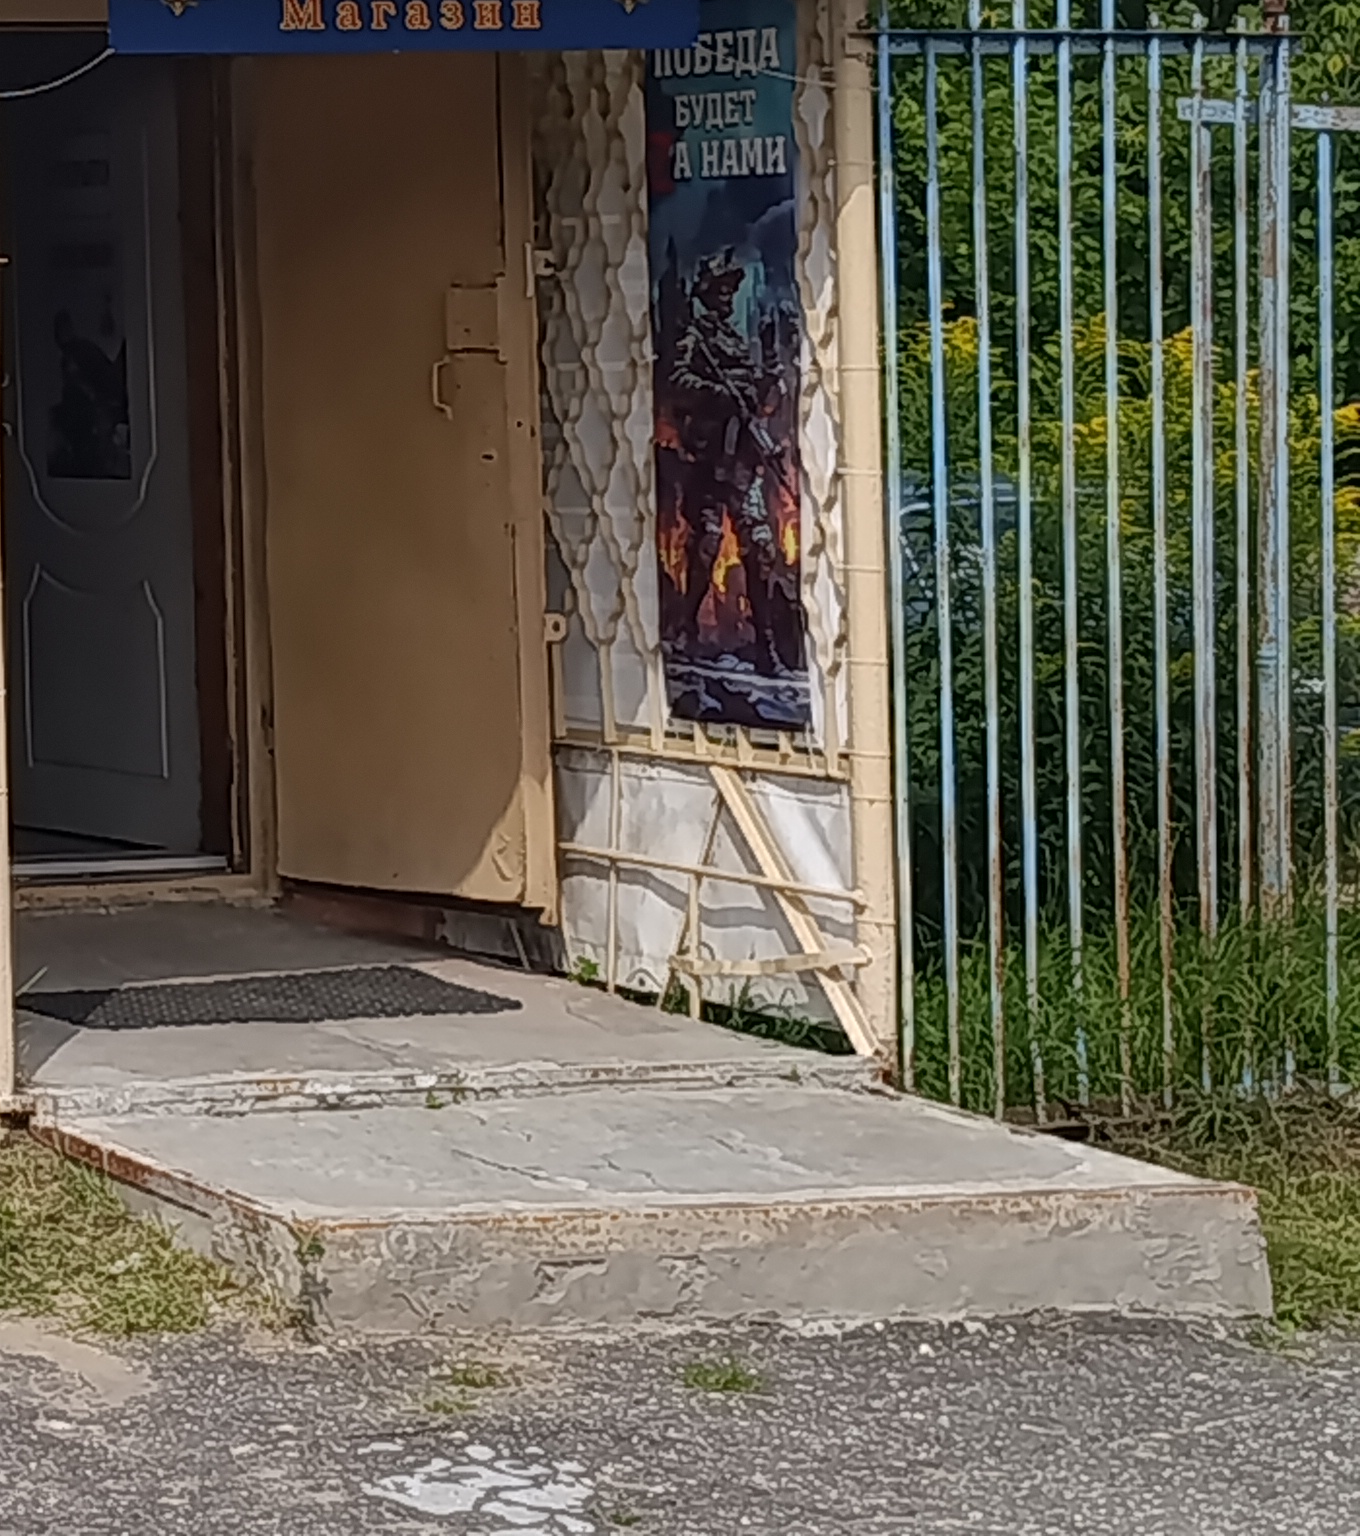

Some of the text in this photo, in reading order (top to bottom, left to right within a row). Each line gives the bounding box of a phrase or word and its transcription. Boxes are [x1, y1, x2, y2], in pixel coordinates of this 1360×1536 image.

[653, 27, 780, 78] ПОБЕДА
[673, 89, 757, 131] БУДЕТ
[700, 135, 788, 178] НАМИ
